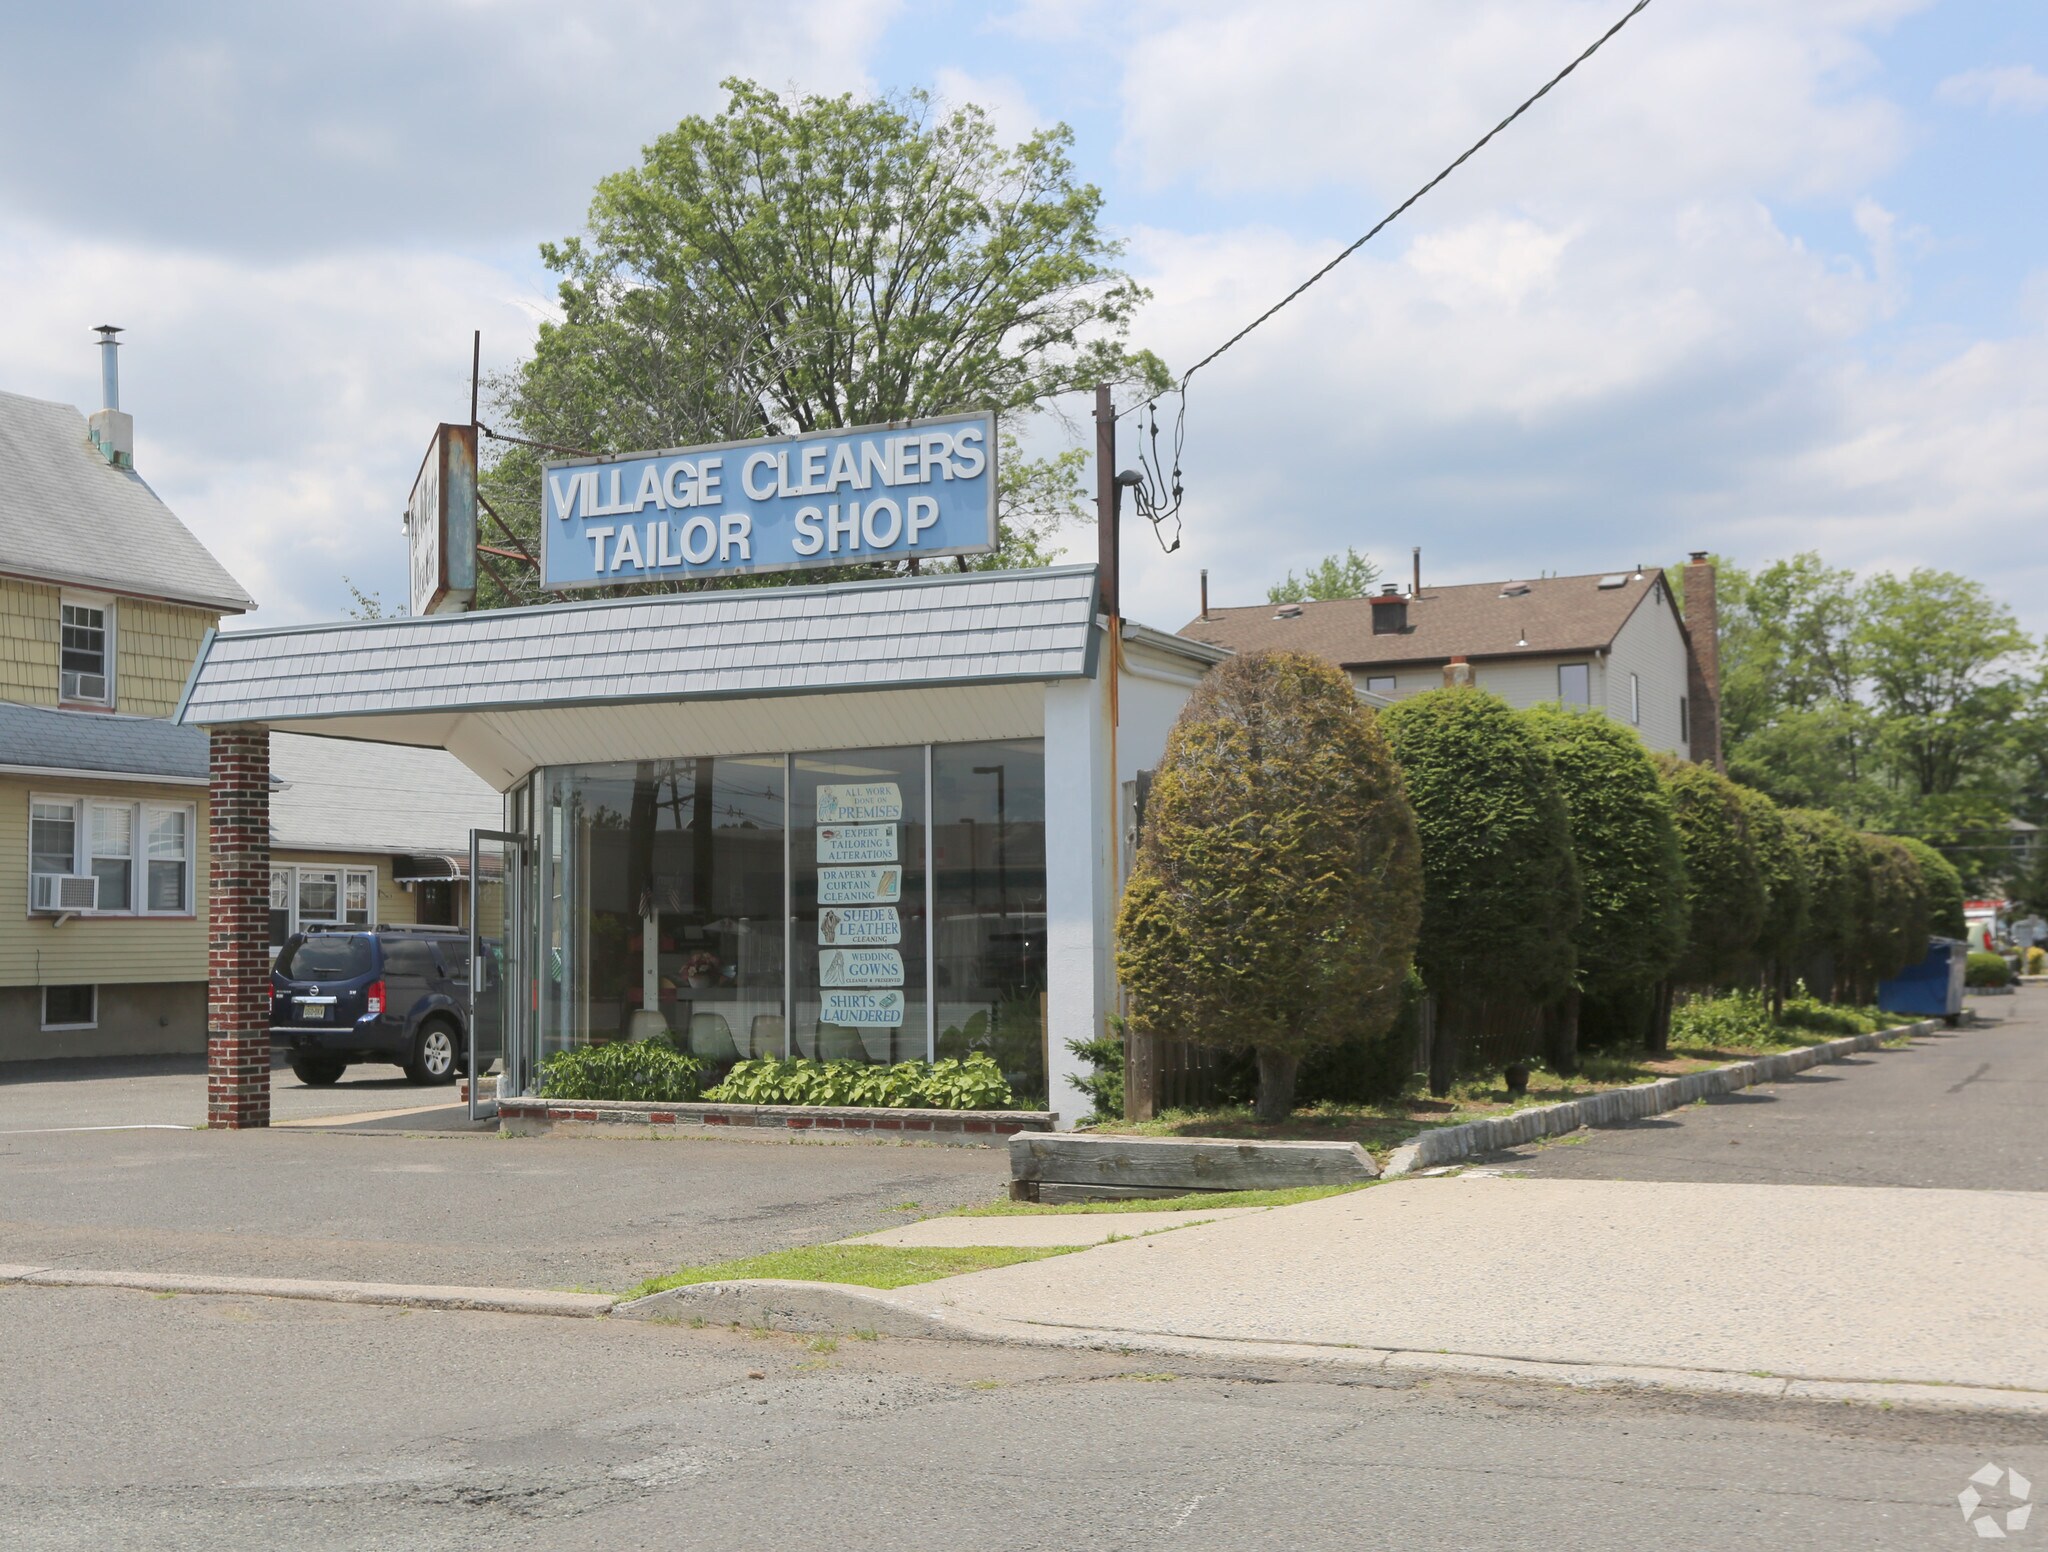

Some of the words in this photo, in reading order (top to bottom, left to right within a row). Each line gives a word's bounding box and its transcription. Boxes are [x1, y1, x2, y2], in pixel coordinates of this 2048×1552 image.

[549, 457, 723, 520] VILLAGE
[742, 427, 987, 501] CLEANERS
[585, 513, 753, 572] TAILOR
[792, 496, 940, 555] SHOP
[845, 788, 862, 797] ALL
[866, 787, 892, 796] WORK
[838, 806, 899, 818] PREMISES
[845, 829, 879, 838] EXPERT
[831, 839, 882, 849] TAILORING
[829, 850, 892, 860] ALTERATIONS
[823, 870, 867, 880] DRAPERY
[871, 869, 877, 878] &
[826, 880, 870, 890] CURTAIN
[824, 891, 875, 901] CLEANING
[843, 909, 884, 921] SUEDE
[887, 909, 894, 920] &
[839, 922, 899, 935] LEATHER
[852, 935, 888, 943] CLEANING
[851, 952, 894, 961] WEDDING
[849, 964, 898, 975] GOWNS
[830, 995, 876, 1008] SHIRTS
[823, 1010, 901, 1022] LAUNDERED
